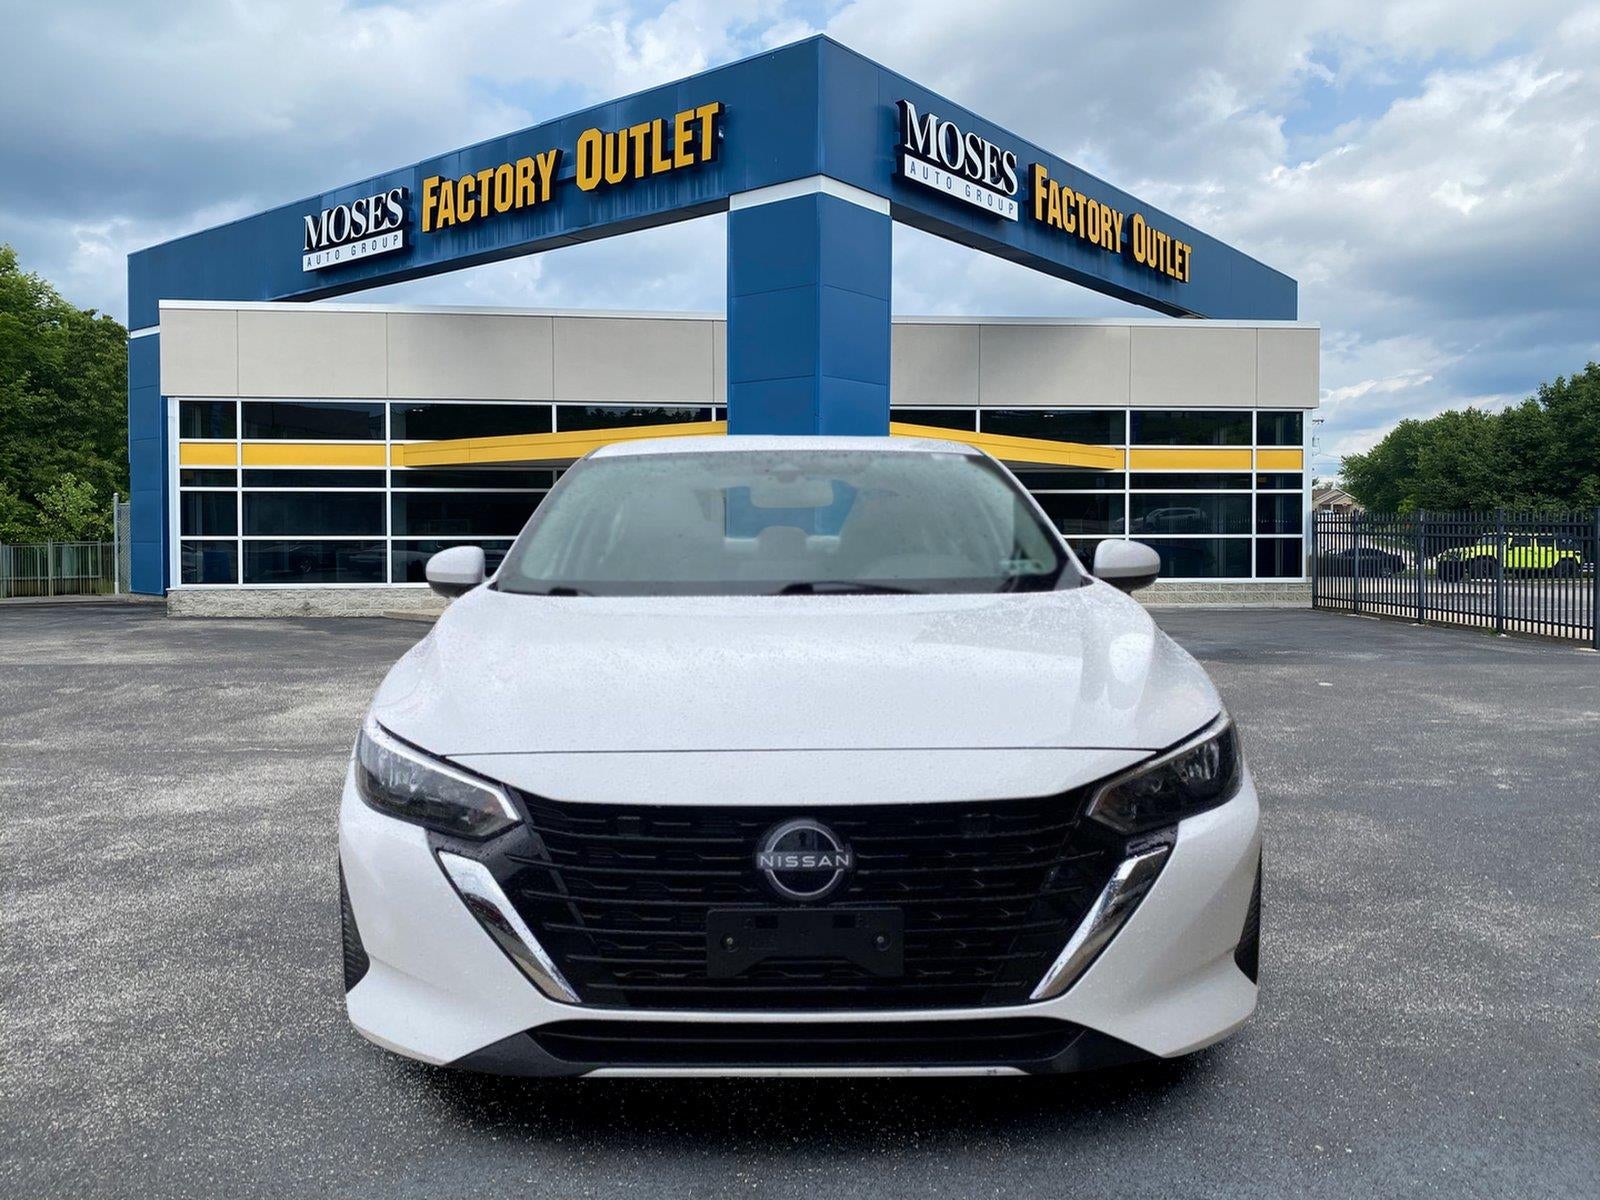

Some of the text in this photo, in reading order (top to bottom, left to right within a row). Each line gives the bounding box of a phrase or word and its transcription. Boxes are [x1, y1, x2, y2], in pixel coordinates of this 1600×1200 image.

[422, 101, 721, 233] FACTORY OUTLET
[904, 99, 1019, 196] MOSES
[303, 188, 404, 251] MOSES
[909, 161, 1014, 215] AUTO GROUP
[307, 235, 399, 267] AUTO GROUP
[1033, 163, 1192, 283] FACTORY OUTLET
[760, 855, 849, 867] NISSAN
